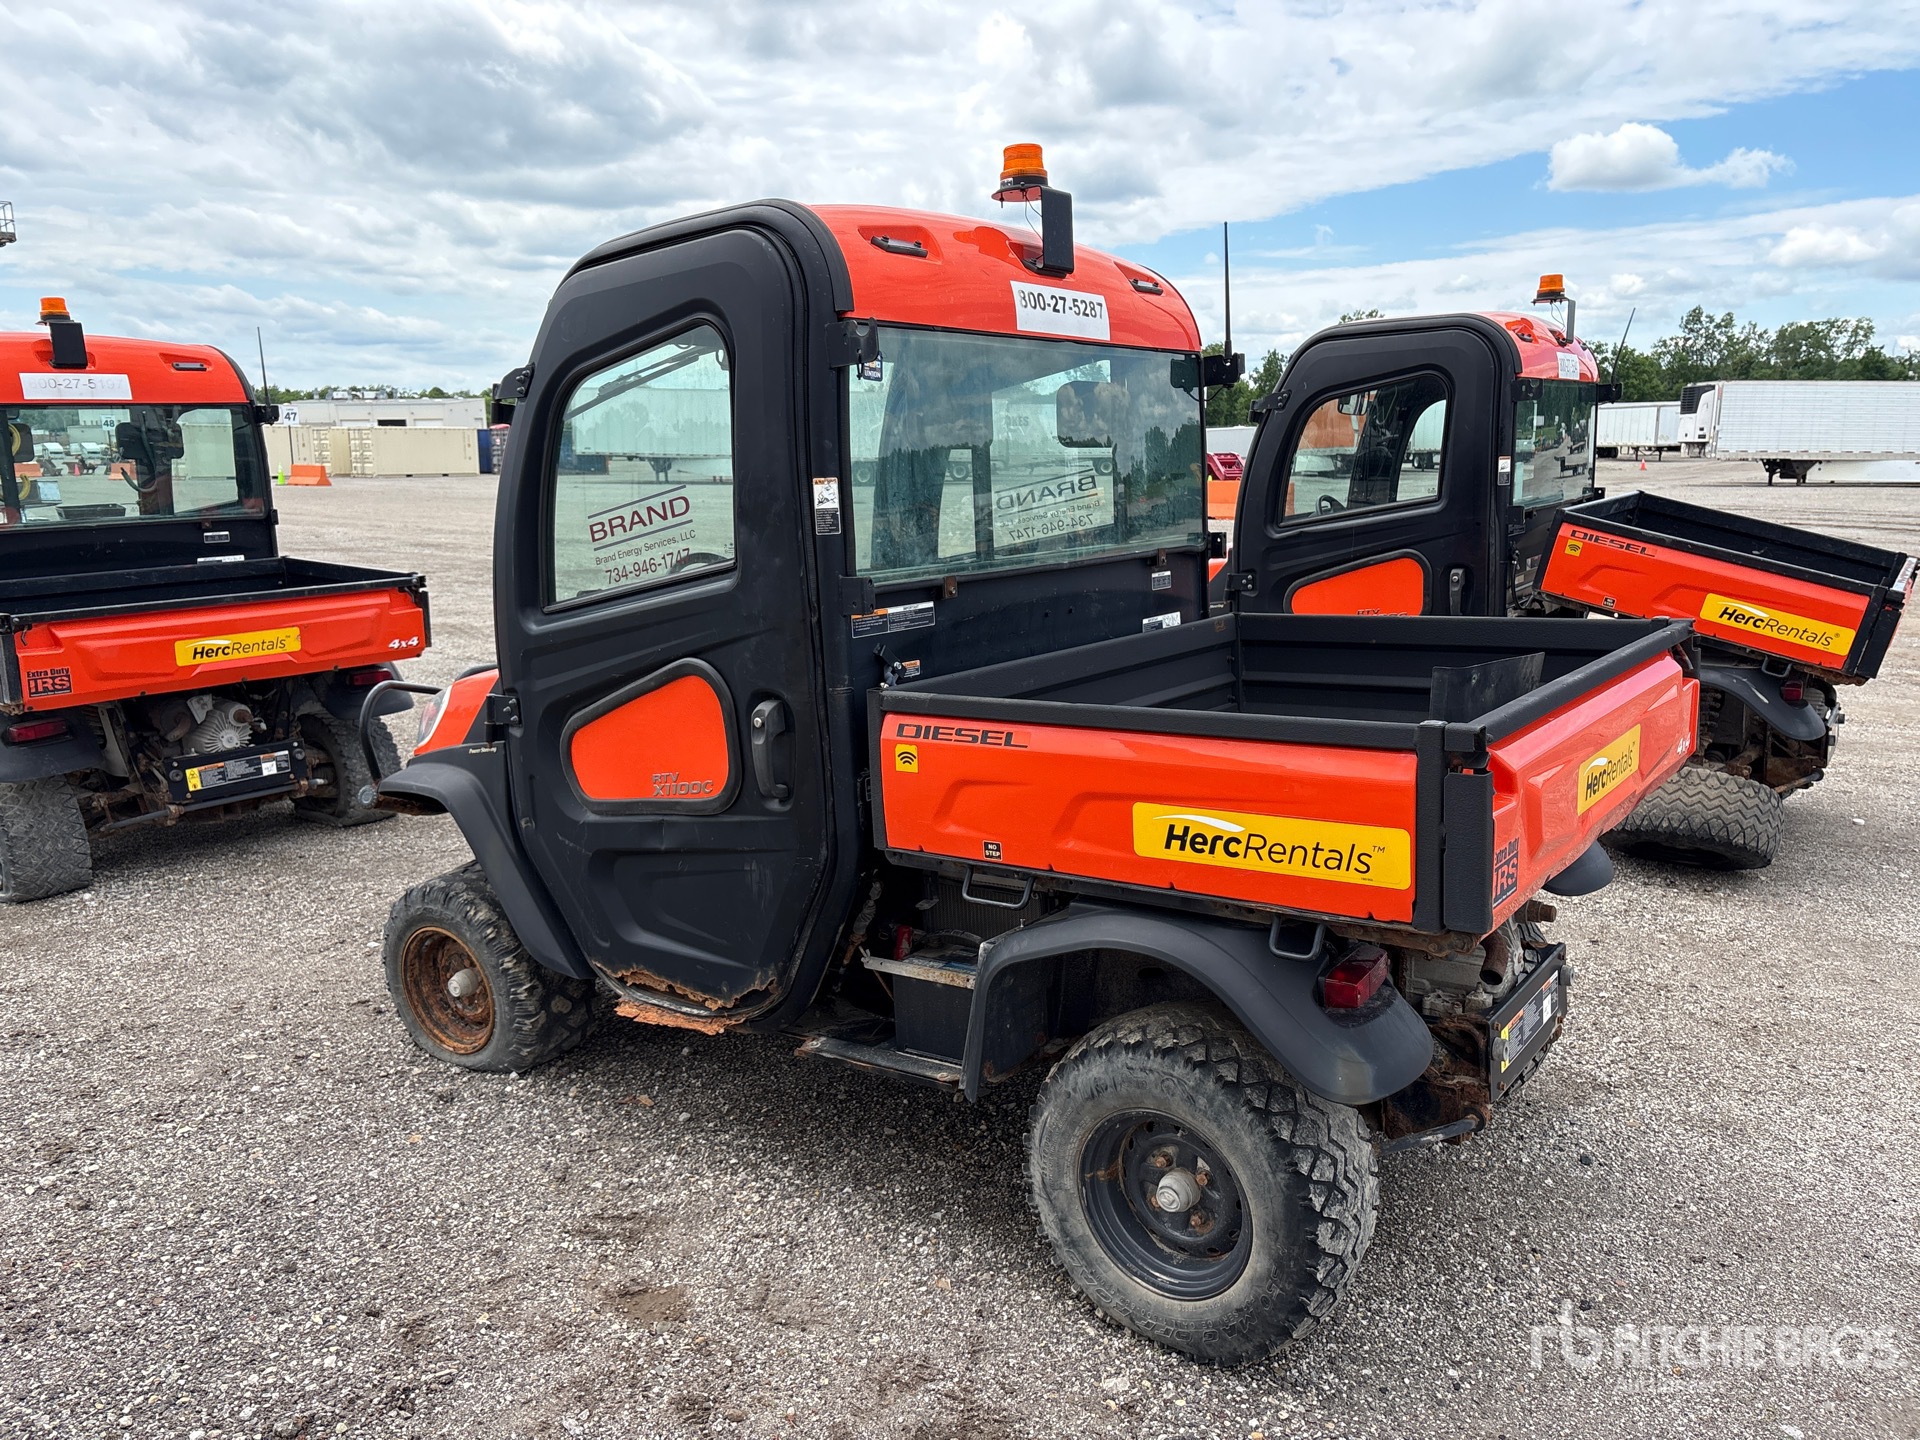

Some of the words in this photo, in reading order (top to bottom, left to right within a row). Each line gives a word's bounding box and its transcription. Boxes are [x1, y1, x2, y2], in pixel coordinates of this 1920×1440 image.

[1018, 289, 1103, 320] 800-27-5287
[103, 419, 115, 428] 48
[284, 411, 298, 421] 47
[588, 495, 690, 543] BRAND
[595, 552, 616, 566] Brand
[618, 546, 642, 559] Energy
[643, 536, 679, 552] Services,
[680, 529, 696, 542] LLC
[1570, 529, 1655, 558] DIESEL
[605, 547, 690, 584] 734-946-1747
[192, 637, 286, 660] HercRentals
[388, 636, 419, 649] 4x4
[27, 670, 48, 678] Extra
[50, 667, 70, 676] Duty
[30, 676, 70, 693] IRS
[896, 723, 1029, 748] DIESEL
[652, 772, 680, 783] RTV
[653, 780, 713, 797] X1100C
[1164, 823, 1373, 875] HercRentals
